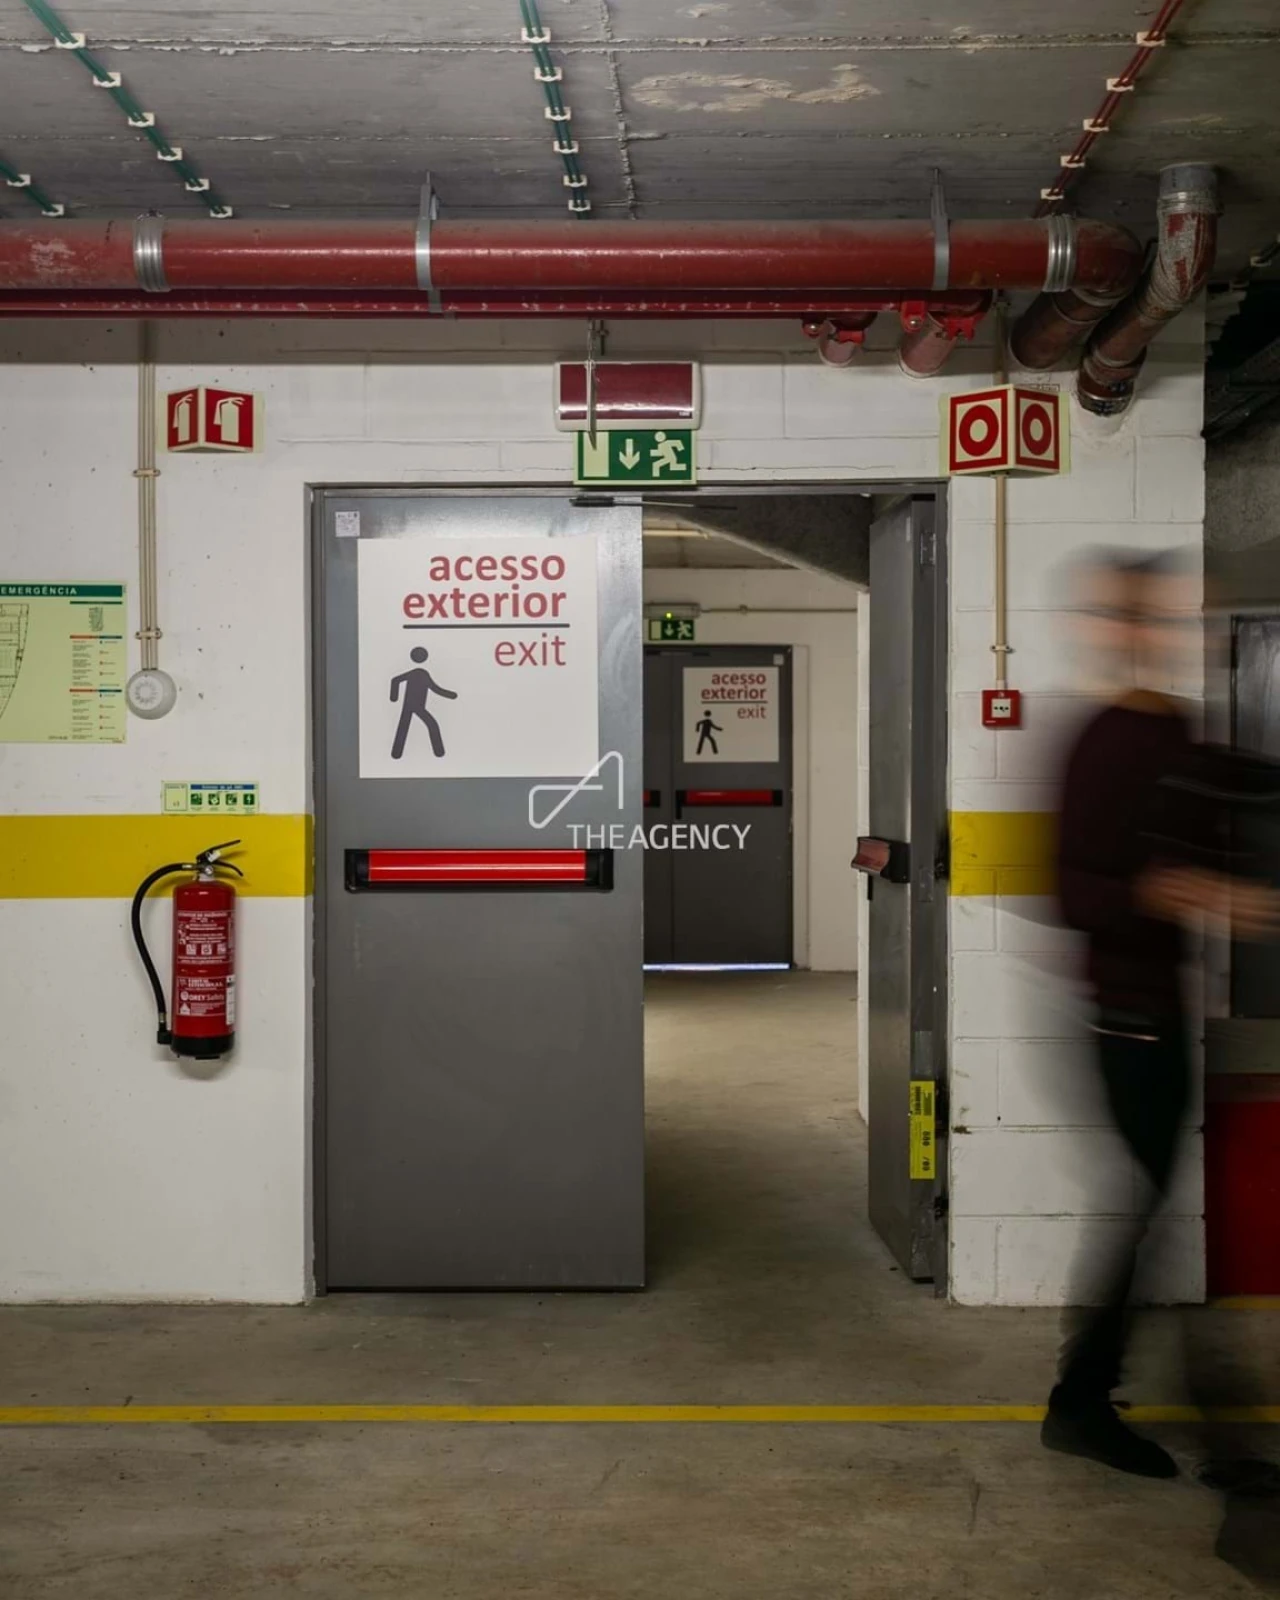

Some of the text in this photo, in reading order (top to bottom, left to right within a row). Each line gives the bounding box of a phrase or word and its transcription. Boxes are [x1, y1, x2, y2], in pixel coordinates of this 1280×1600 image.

[429, 554, 566, 581] acesso
[1, 584, 77, 596] EMERGÊNCIA
[403, 584, 566, 619] exterior
[494, 633, 566, 667] exit
[711, 673, 766, 685] acesso
[701, 685, 766, 700] exterior
[737, 704, 766, 719] exit
